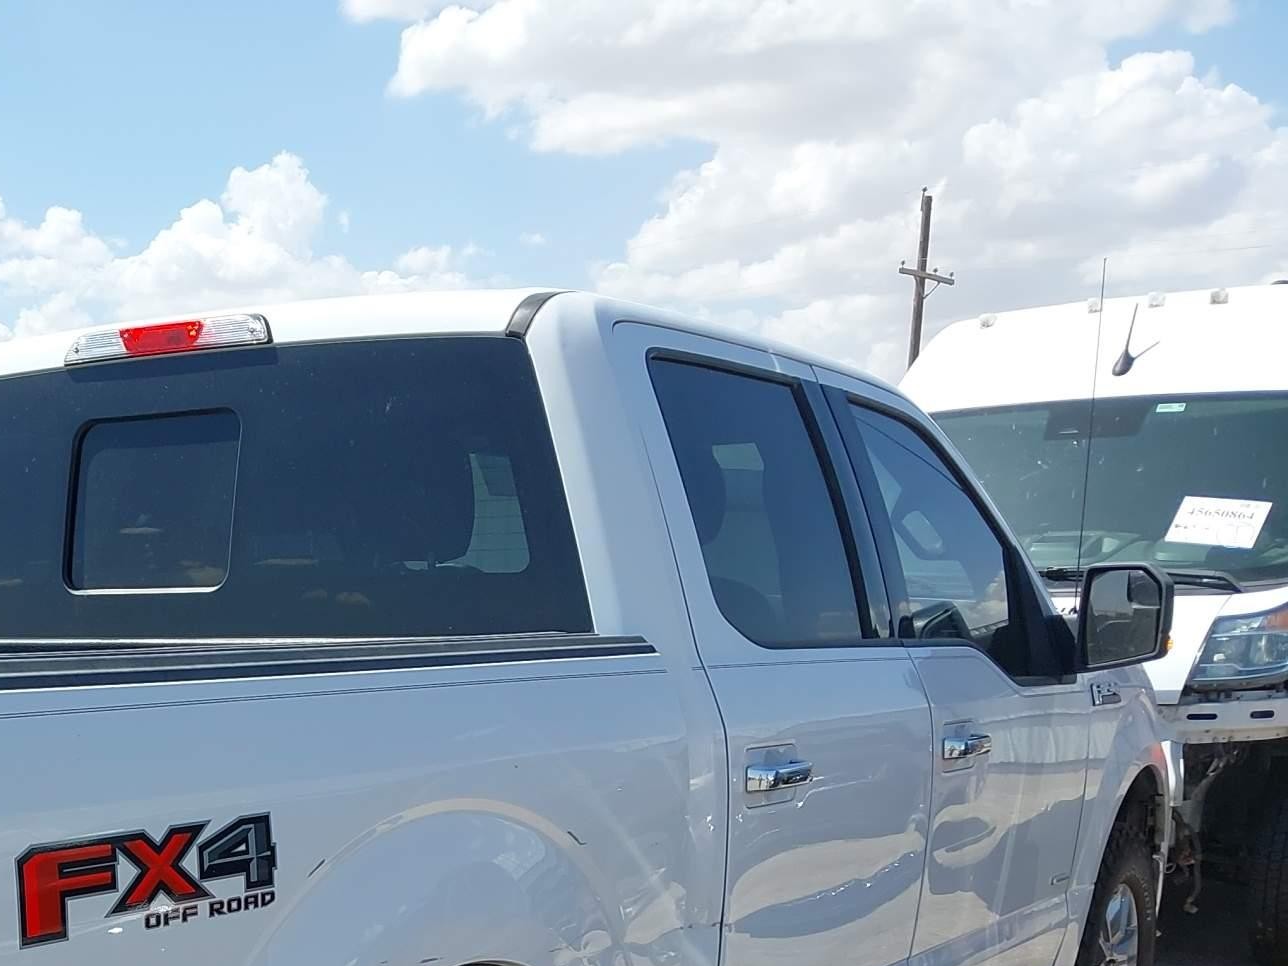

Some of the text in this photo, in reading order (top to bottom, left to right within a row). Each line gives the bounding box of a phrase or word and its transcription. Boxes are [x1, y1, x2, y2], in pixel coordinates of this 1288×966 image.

[14, 812, 277, 950] FX4
[145, 890, 275, 930] OFF ROAD
